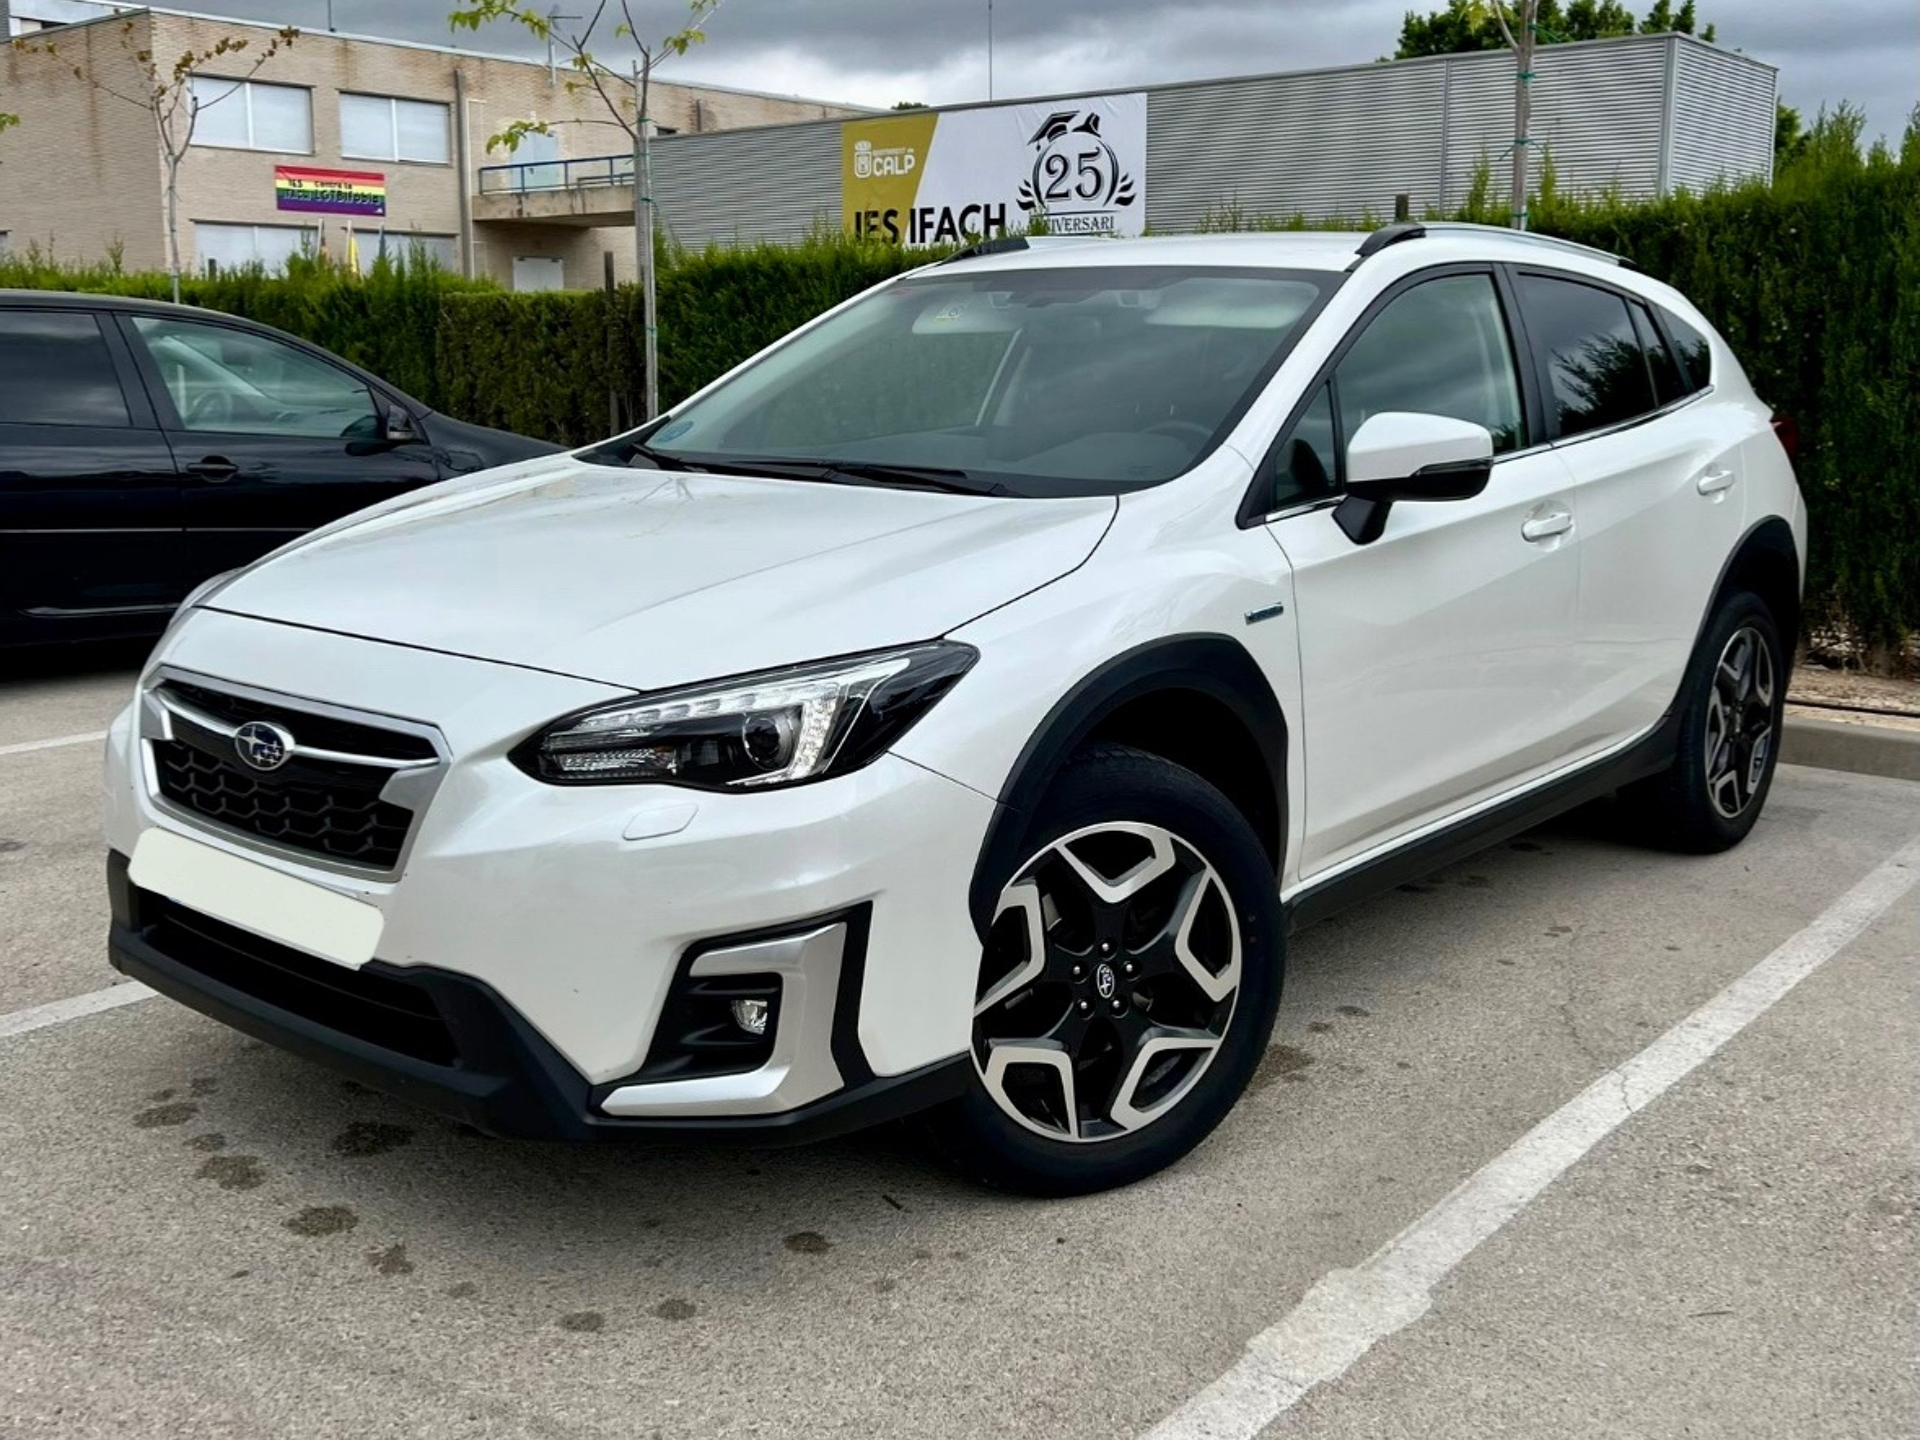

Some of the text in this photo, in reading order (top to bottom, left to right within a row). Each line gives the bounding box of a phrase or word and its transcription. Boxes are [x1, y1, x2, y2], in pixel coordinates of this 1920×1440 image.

[873, 154, 916, 177] CALP
[1045, 146, 1104, 202] 25
[854, 203, 1006, 245] IES IFACH
[1045, 216, 1115, 233] IVERSARI
